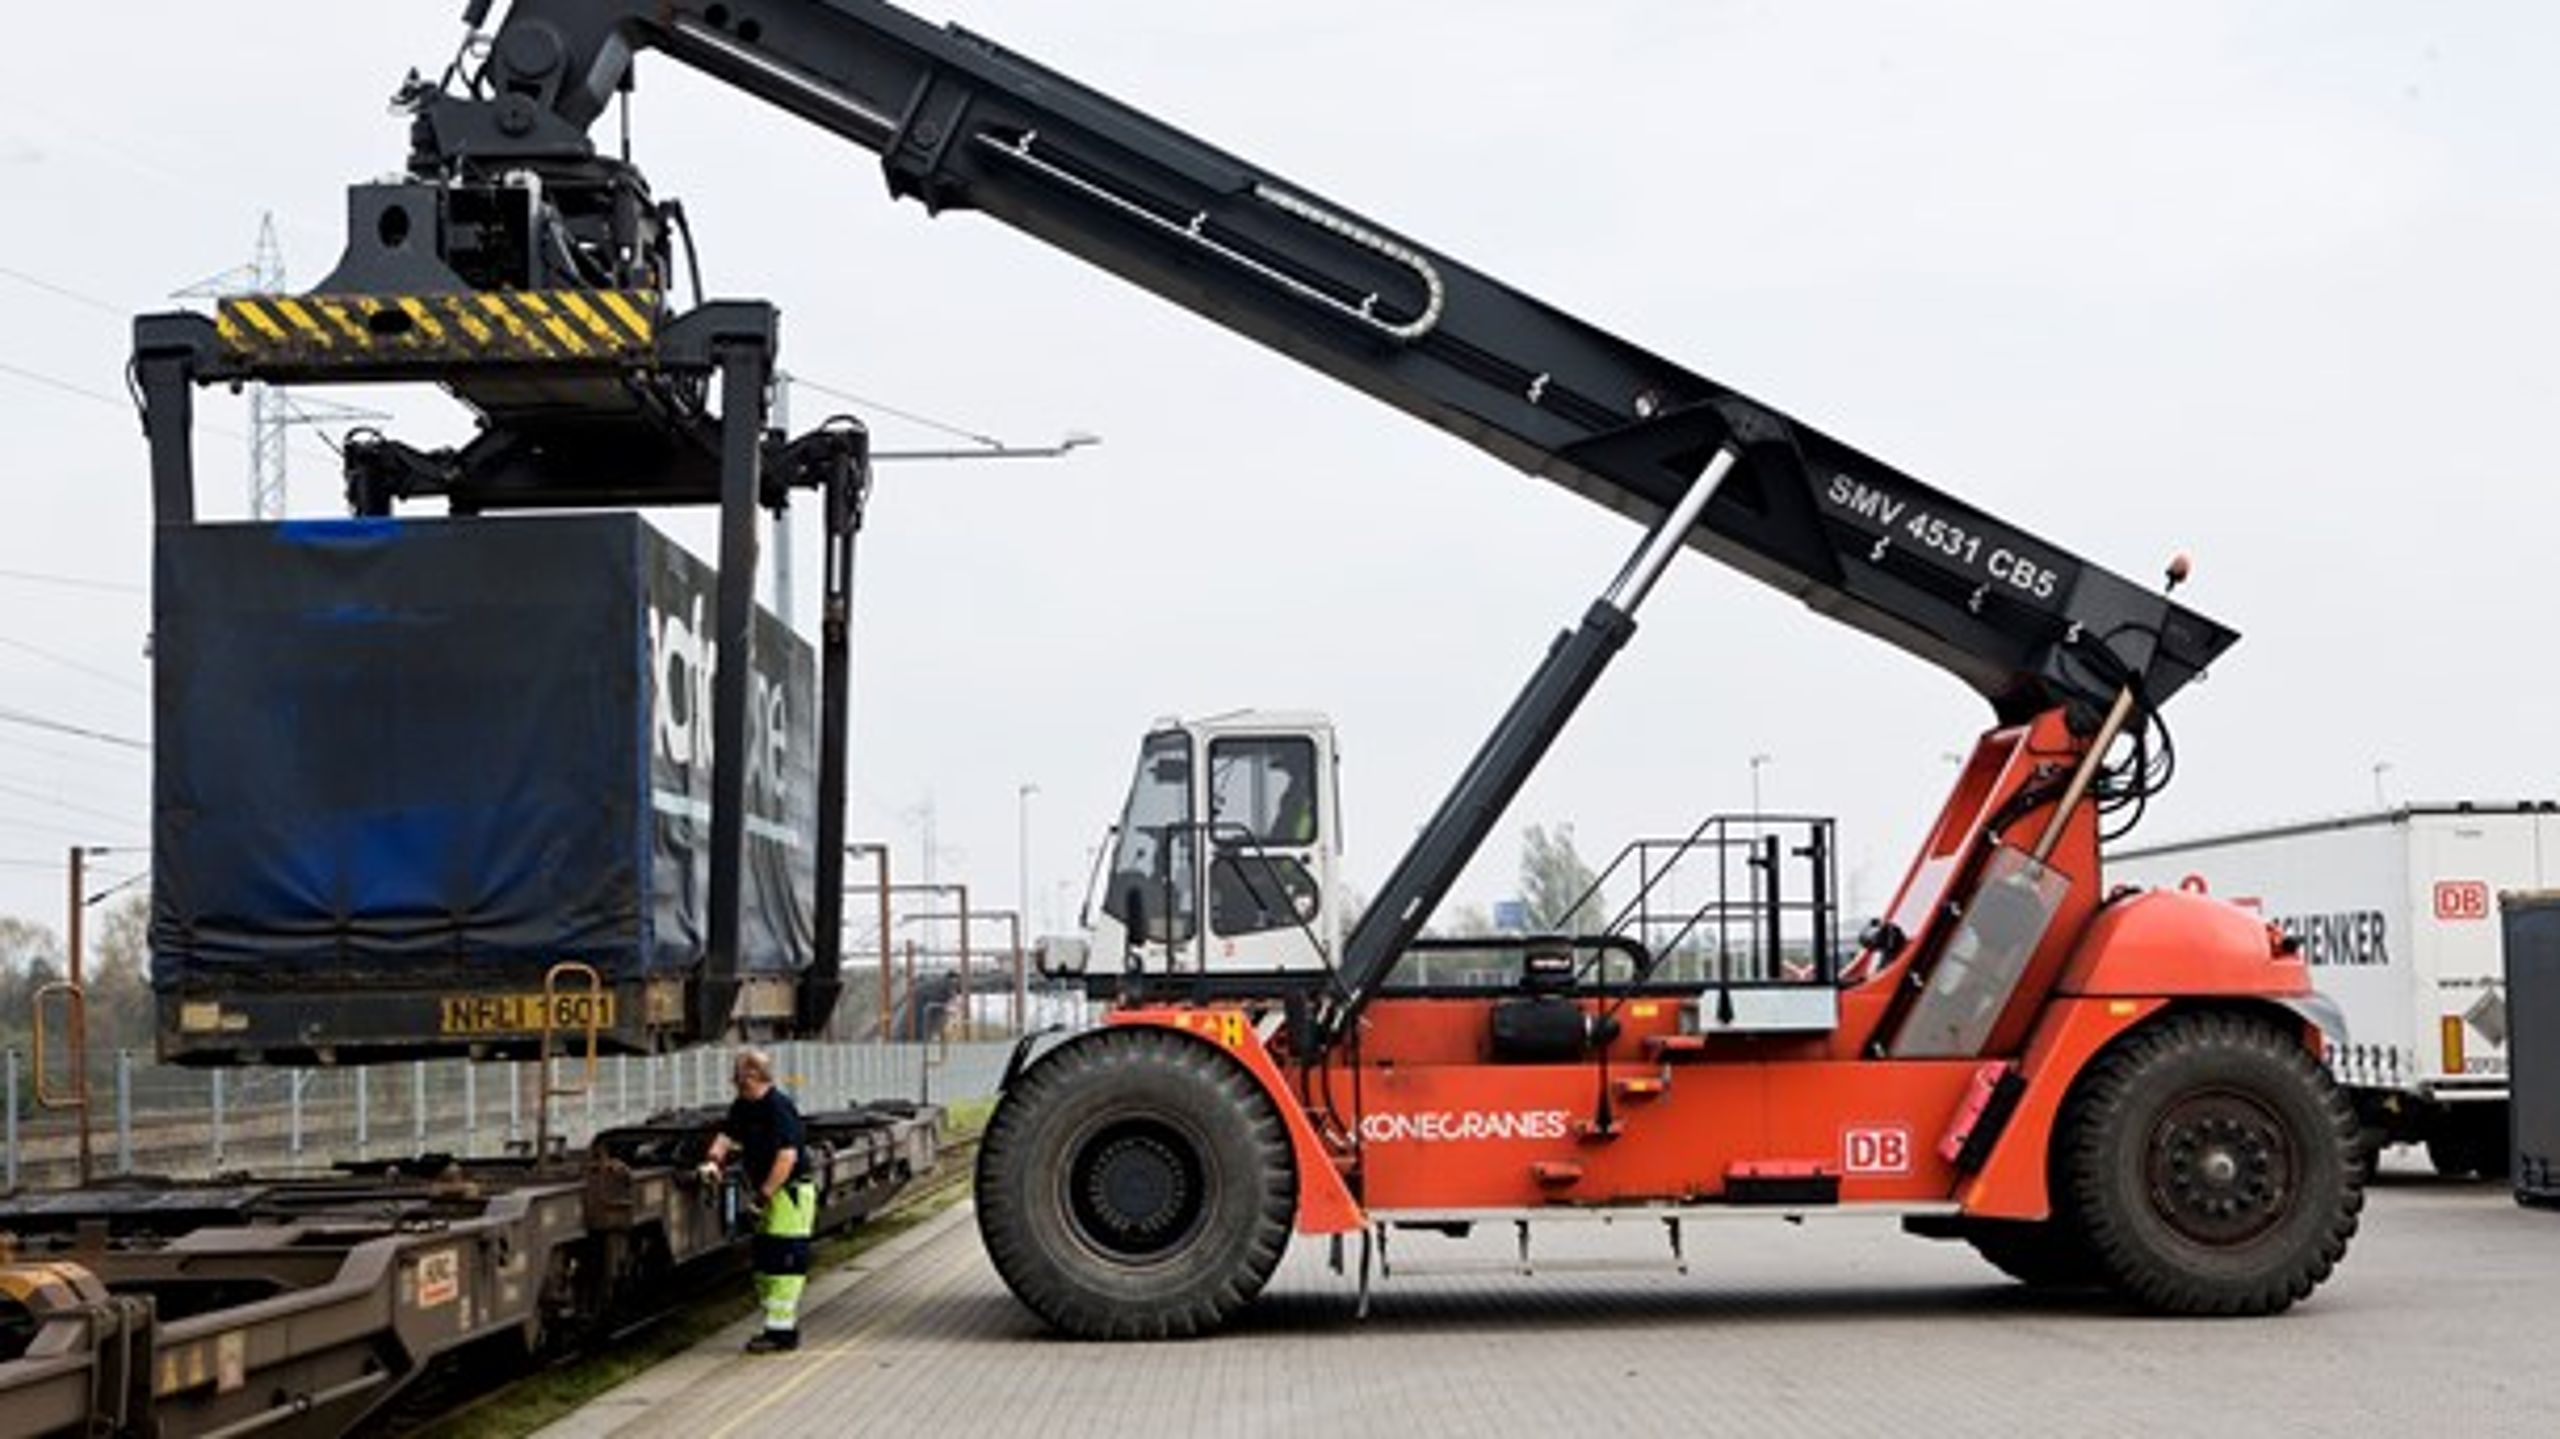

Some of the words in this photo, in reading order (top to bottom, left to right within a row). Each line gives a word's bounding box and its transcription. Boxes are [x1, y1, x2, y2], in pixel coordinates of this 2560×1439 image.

[1828, 473, 1905, 526] SMV
[1906, 511, 1982, 565] 4531
[1987, 548, 2058, 599] CB5
[2440, 887, 2483, 914] DB
[2272, 910, 2389, 965] CHENKER
[1359, 1110, 1568, 1142] KONECRANES
[1849, 1134, 1904, 1169] DB
